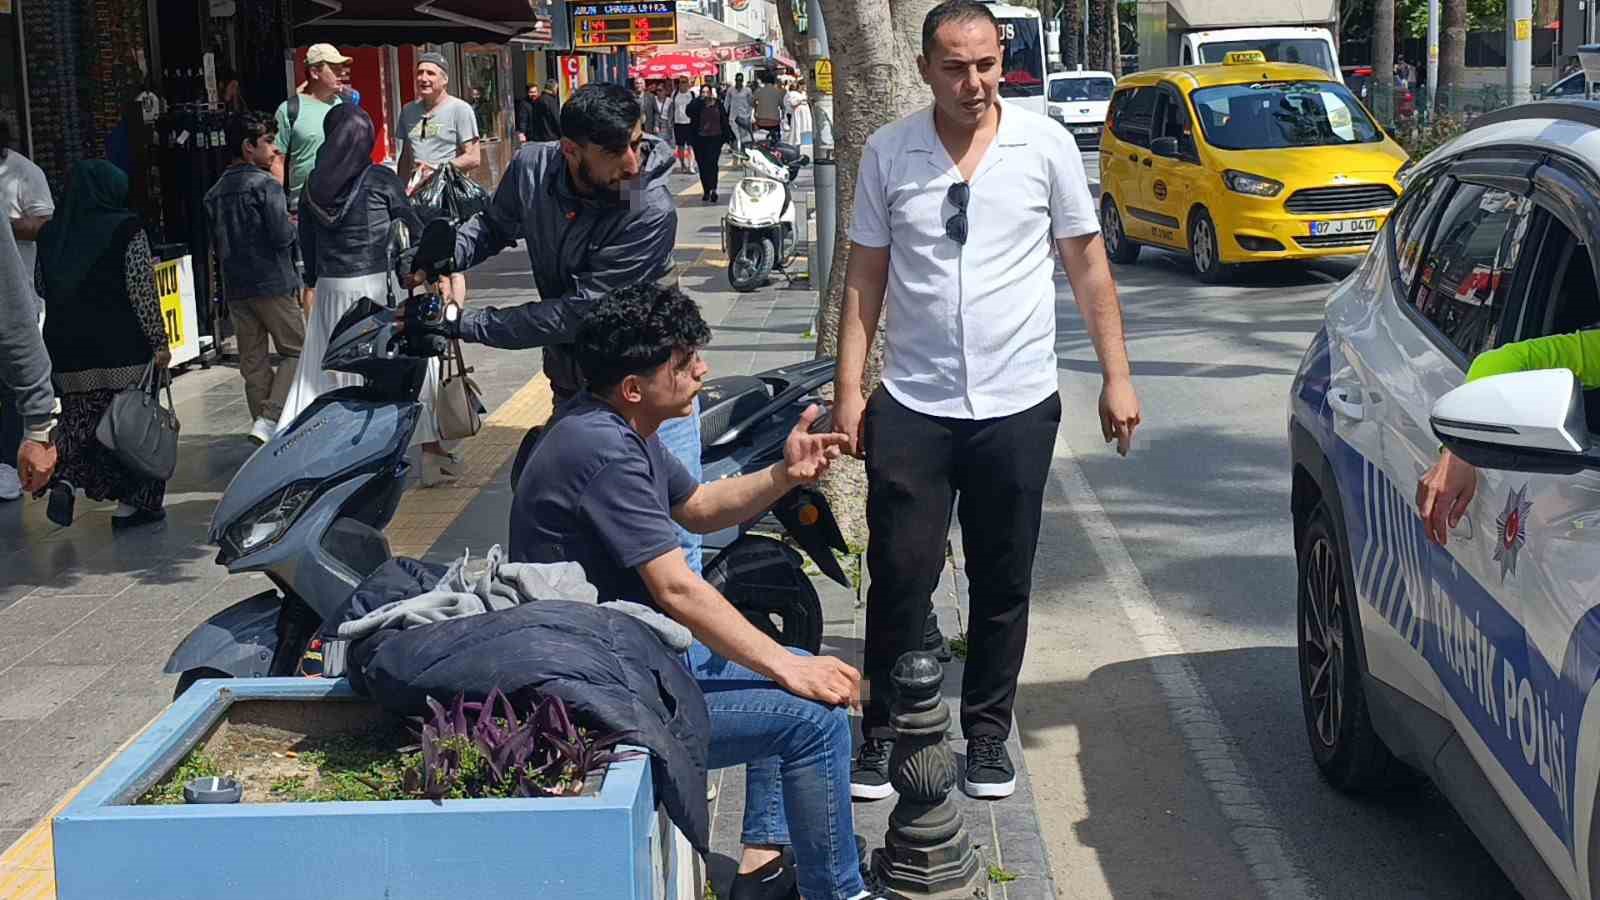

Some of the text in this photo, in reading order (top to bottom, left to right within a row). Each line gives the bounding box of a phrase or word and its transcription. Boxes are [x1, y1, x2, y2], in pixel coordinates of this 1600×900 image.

[567, 57, 579, 93] CH
[155, 264, 178, 297] VLU
[1432, 576, 1570, 825] TRAFİK POLİSİ
